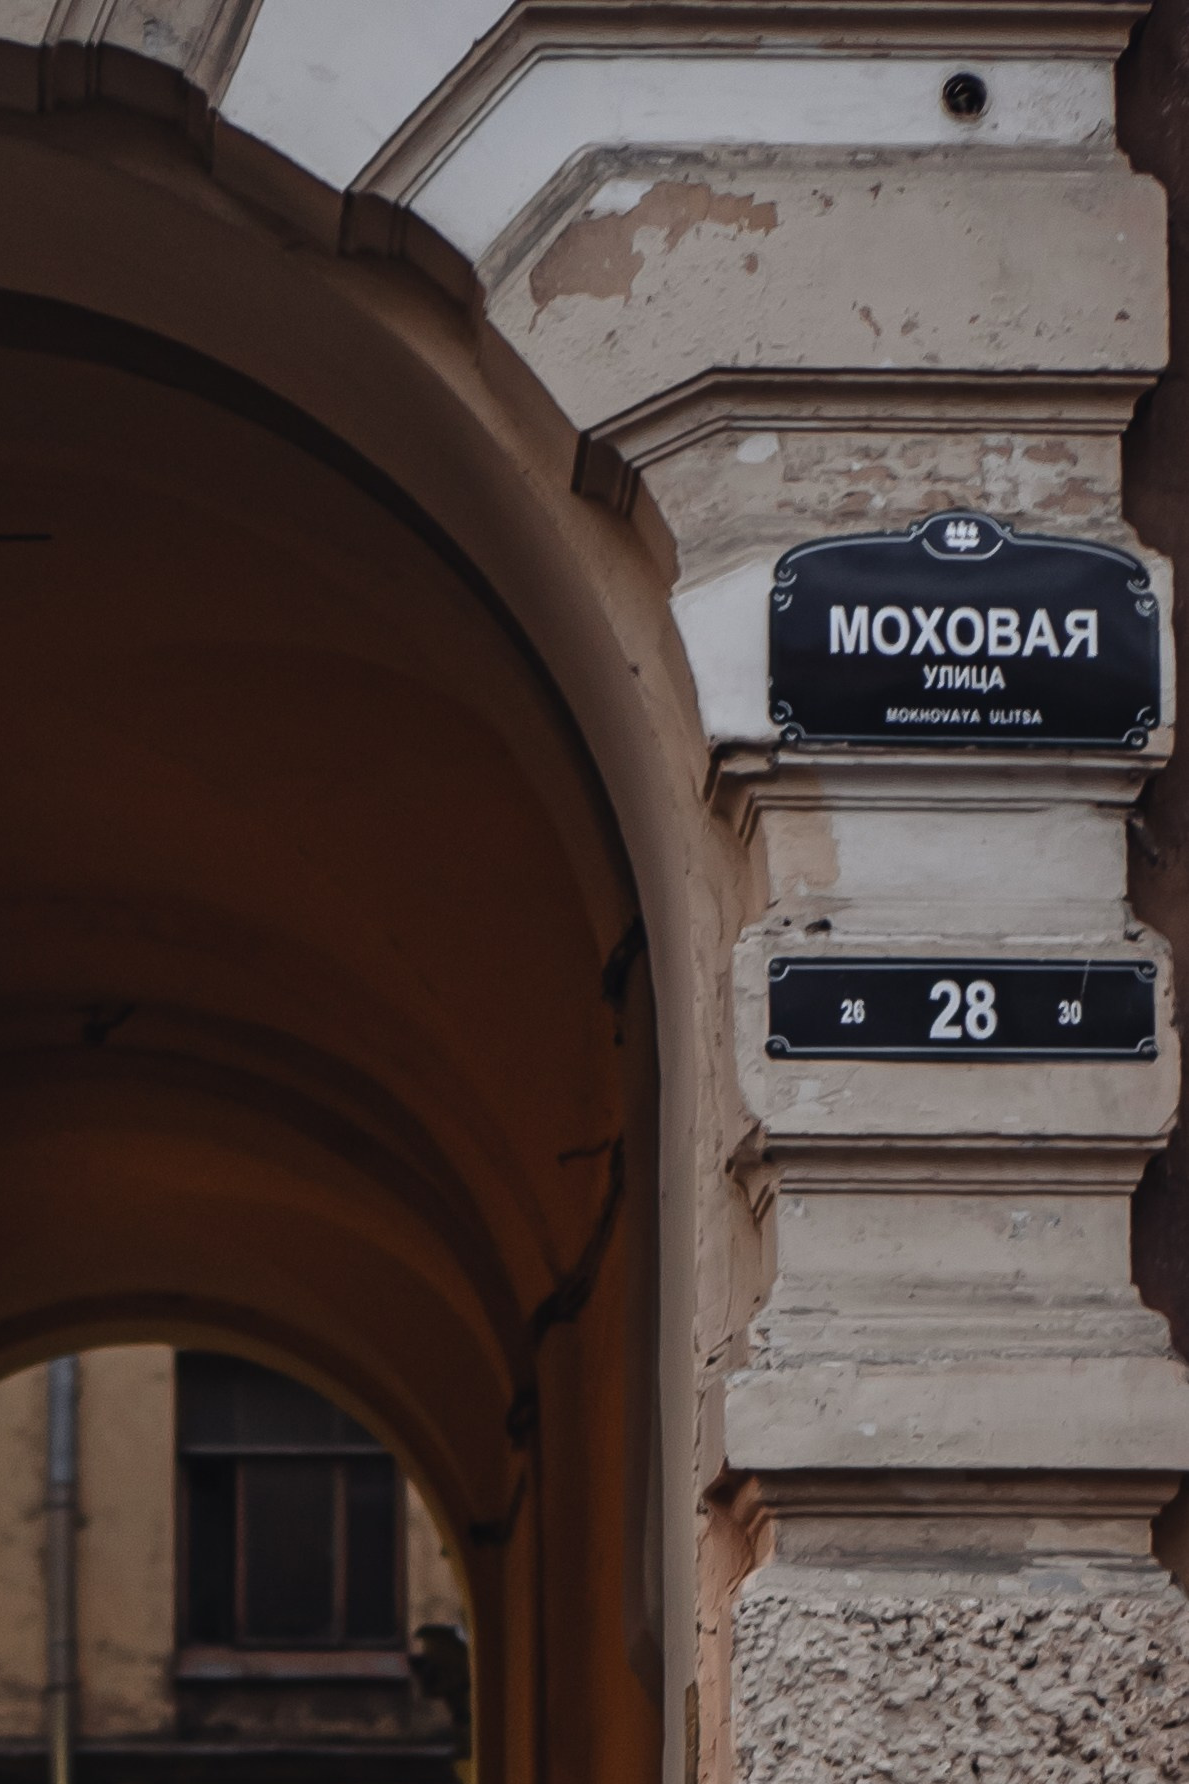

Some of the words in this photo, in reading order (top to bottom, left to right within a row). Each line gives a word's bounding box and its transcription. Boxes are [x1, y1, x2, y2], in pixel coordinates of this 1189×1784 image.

[829, 604, 1099, 658] МОХОВАЯ
[922, 664, 1006, 694] УЛИЦА
[885, 706, 982, 725] MOKHOVAYA
[988, 708, 1044, 726] ULITSA
[840, 998, 866, 1025] 26
[929, 978, 998, 1040] 28
[1057, 1000, 1083, 1025] 30
